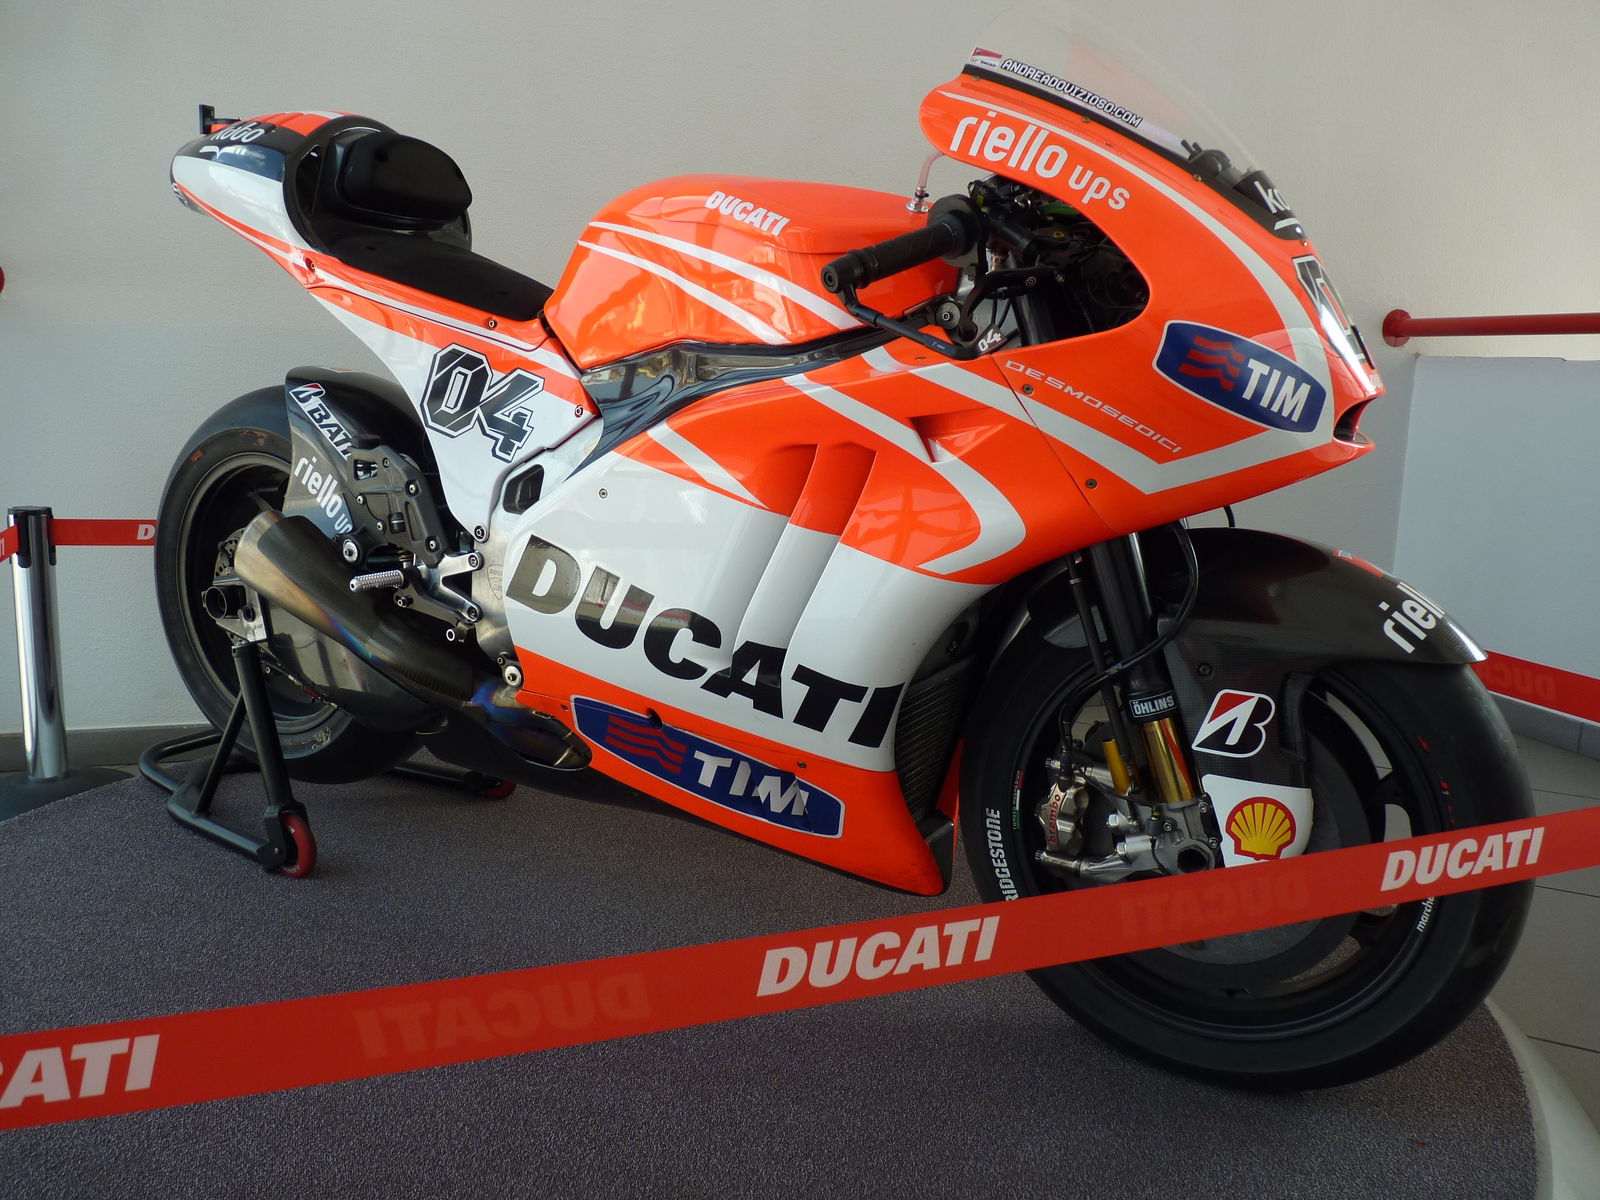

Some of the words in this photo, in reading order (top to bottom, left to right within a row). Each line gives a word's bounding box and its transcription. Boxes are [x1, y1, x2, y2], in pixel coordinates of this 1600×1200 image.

[949, 111, 1069, 179] riello
[1068, 164, 1131, 210] ups
[704, 190, 791, 237] DUCATI
[978, 328, 1002, 352] 04
[420, 342, 545, 464] 04
[1005, 360, 1183, 453] DESMOSEDICI
[1241, 358, 1312, 423] TIM
[307, 403, 352, 457] BAT
[293, 455, 343, 520] riello
[505, 533, 906, 749] DUCATI
[1133, 694, 1175, 716] ÖHLINS
[693, 750, 810, 816] TIM
[1049, 794, 1061, 843] brembo
[985, 808, 1020, 901] RIDGESTONE
[1380, 826, 1546, 892] DUCATI
[756, 915, 1001, 997] DUCATI
[0, 1034, 160, 1110] ATI
